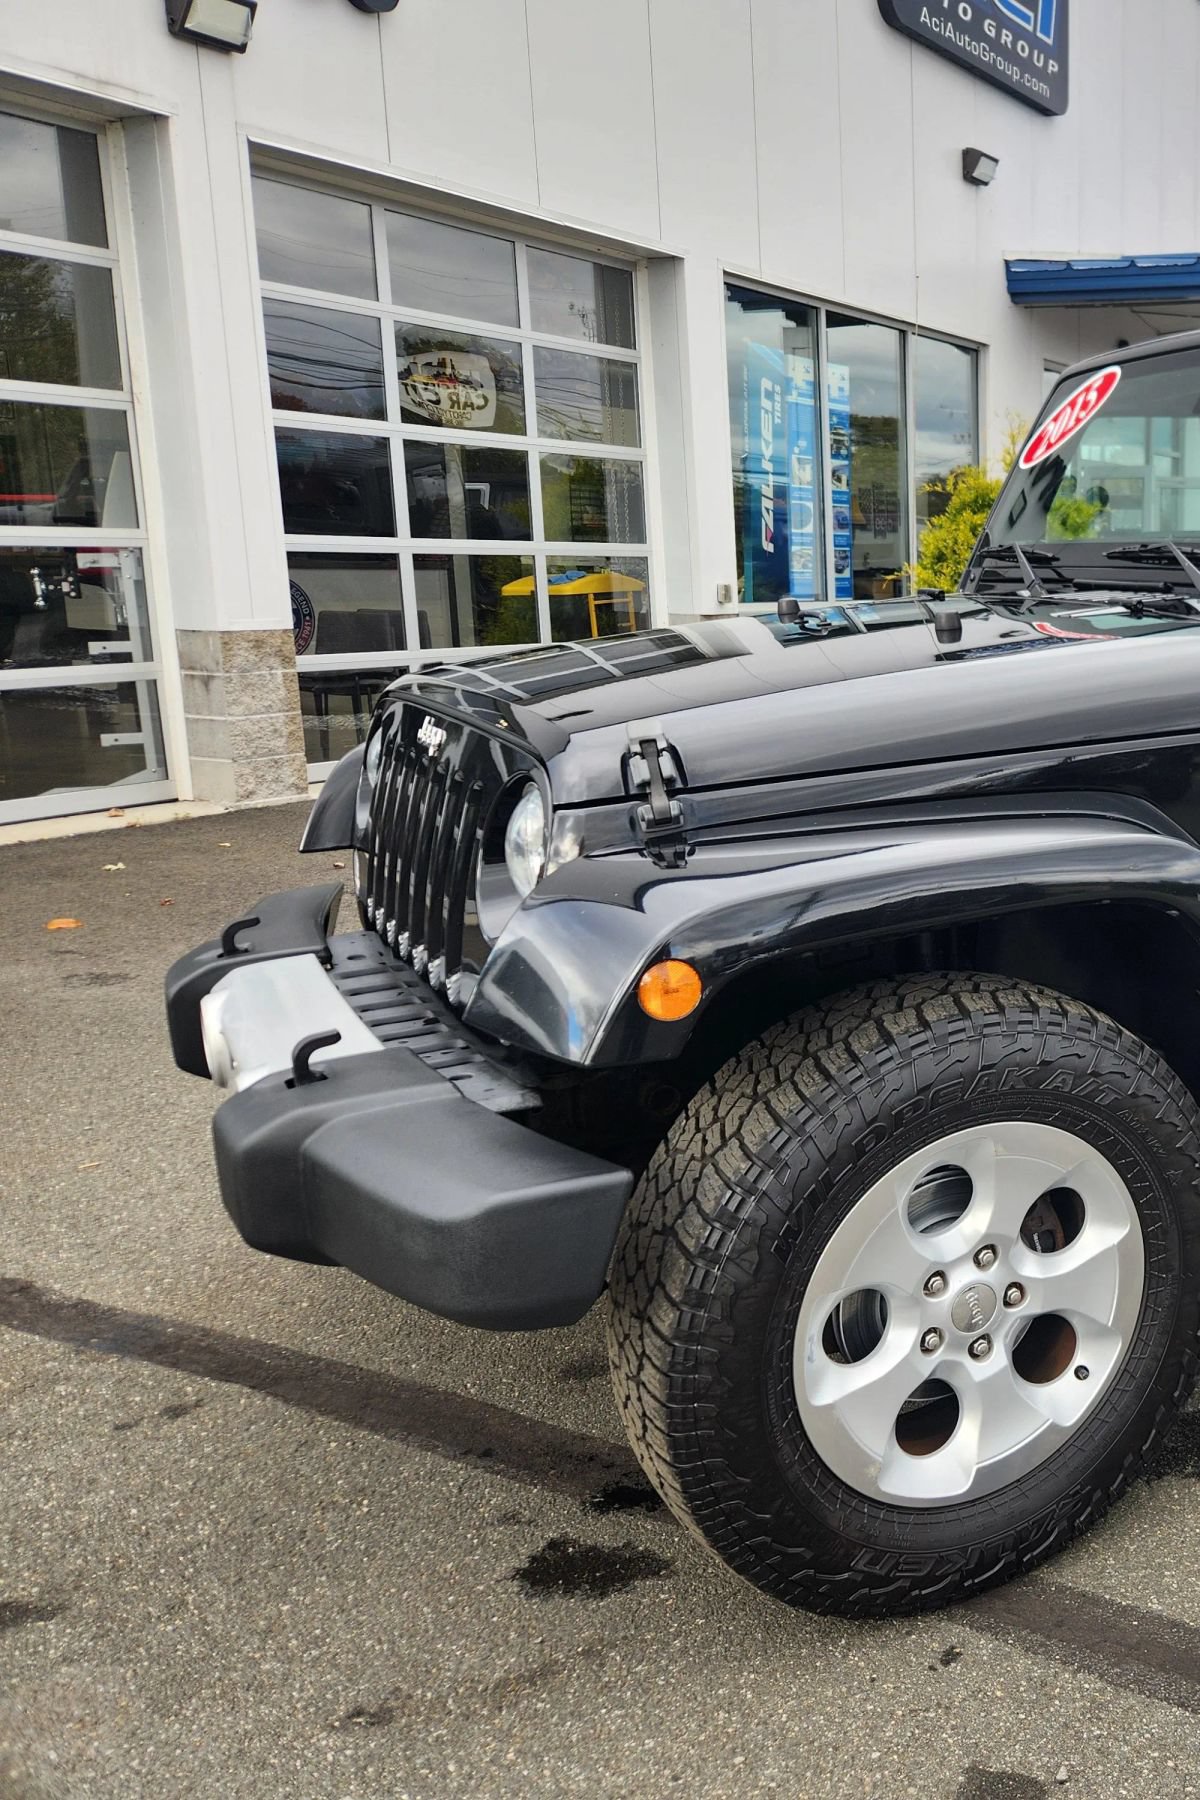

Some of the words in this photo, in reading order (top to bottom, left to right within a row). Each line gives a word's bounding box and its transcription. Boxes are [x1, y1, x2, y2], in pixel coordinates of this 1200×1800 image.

[919, 6, 1051, 99] AciAutoGroup.com
[983, 18, 1059, 74] GROUP
[774, 384, 782, 425] TIRES
[1033, 375, 1105, 460] 2015
[761, 377, 775, 554] FALKEN
[291, 586, 311, 615] EGEND
[771, 1066, 1041, 1268] WILDPEAK
[966, 1292, 984, 1324] Jeep
